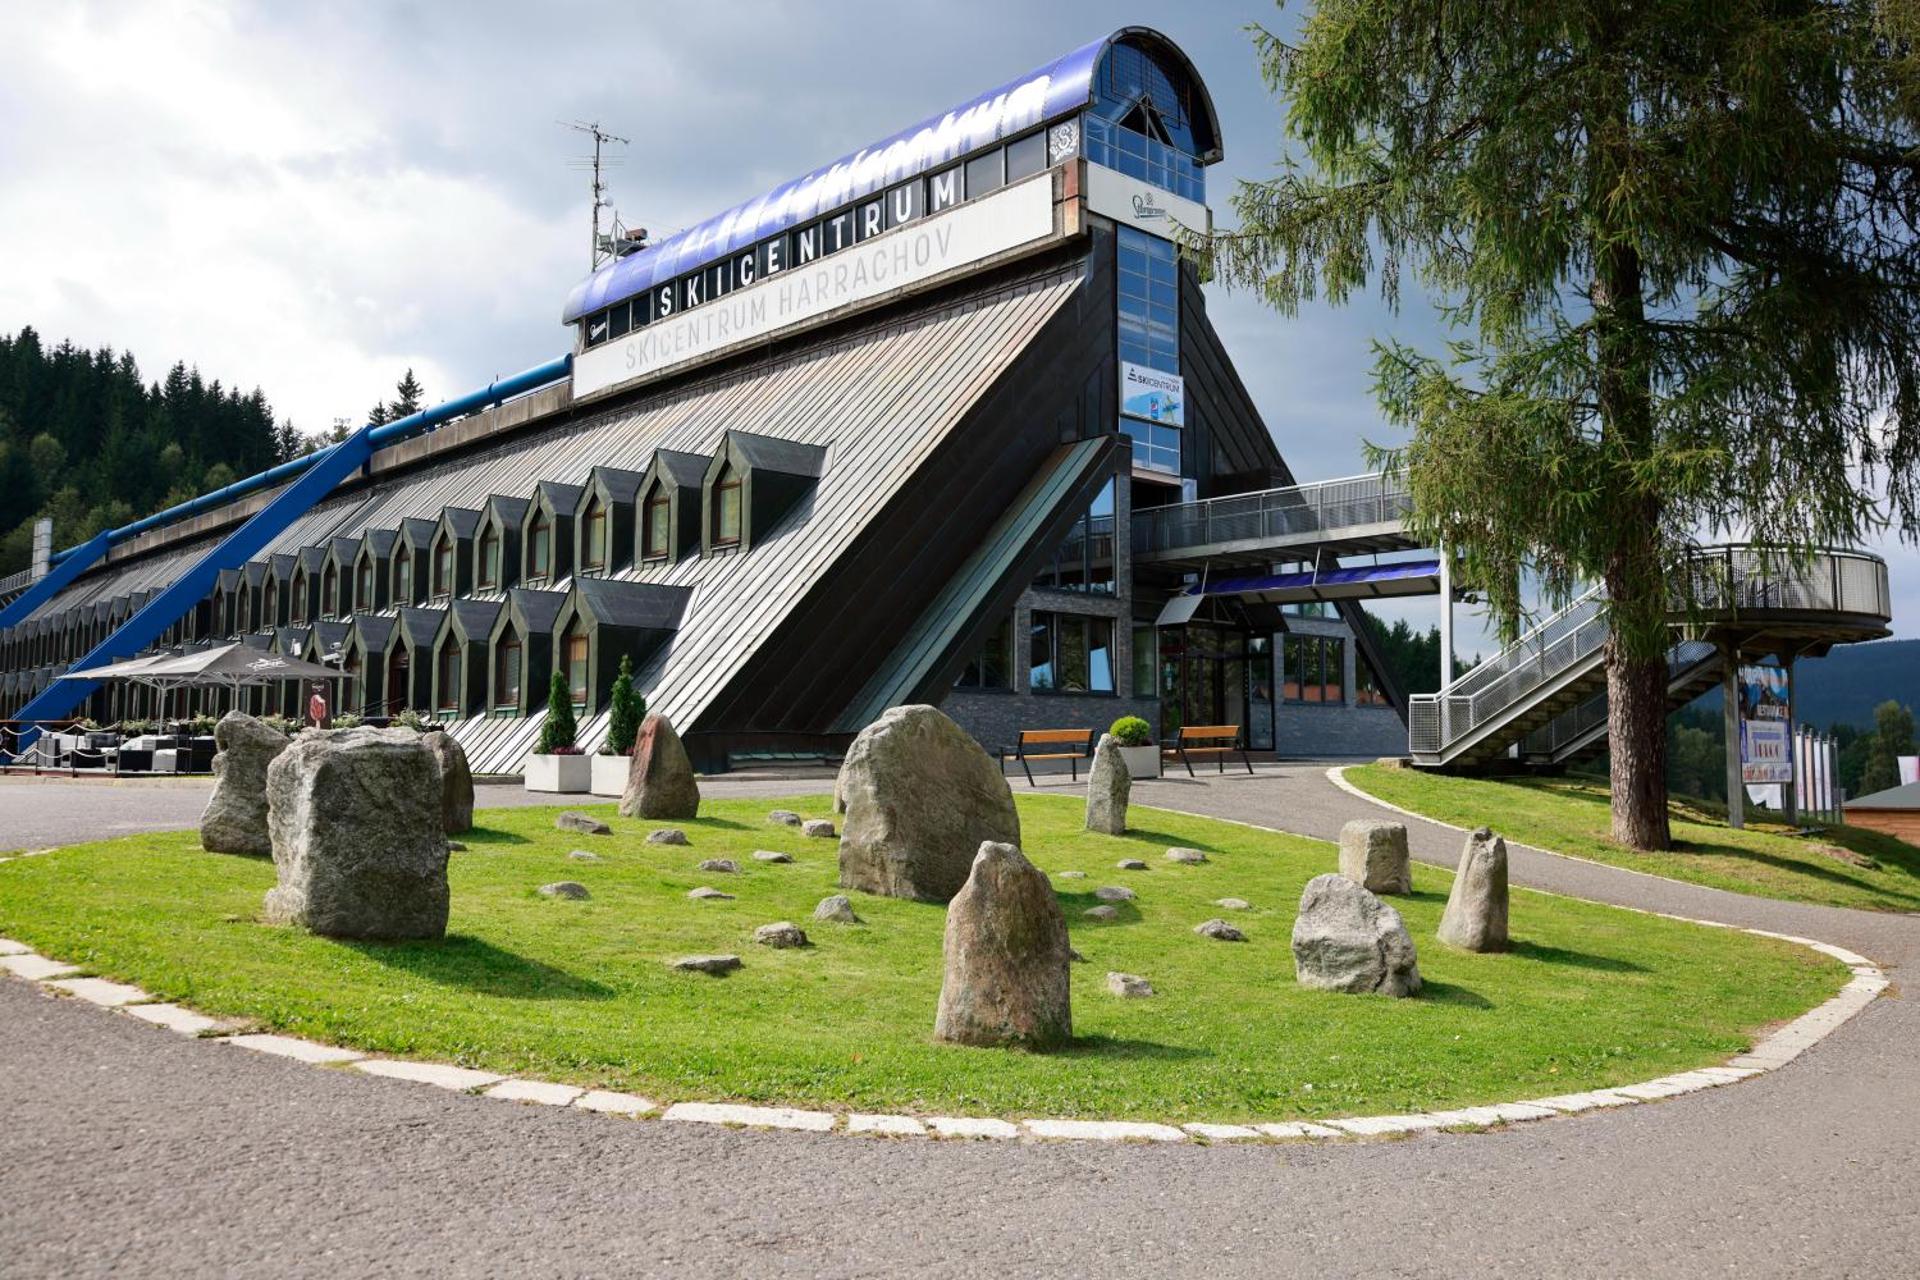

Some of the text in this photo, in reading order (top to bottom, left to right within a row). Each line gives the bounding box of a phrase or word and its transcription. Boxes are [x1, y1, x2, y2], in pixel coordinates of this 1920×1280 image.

[626, 223, 952, 370] SKICENTRUM HARRACHOV
[660, 170, 955, 316] SKICENTRUM
